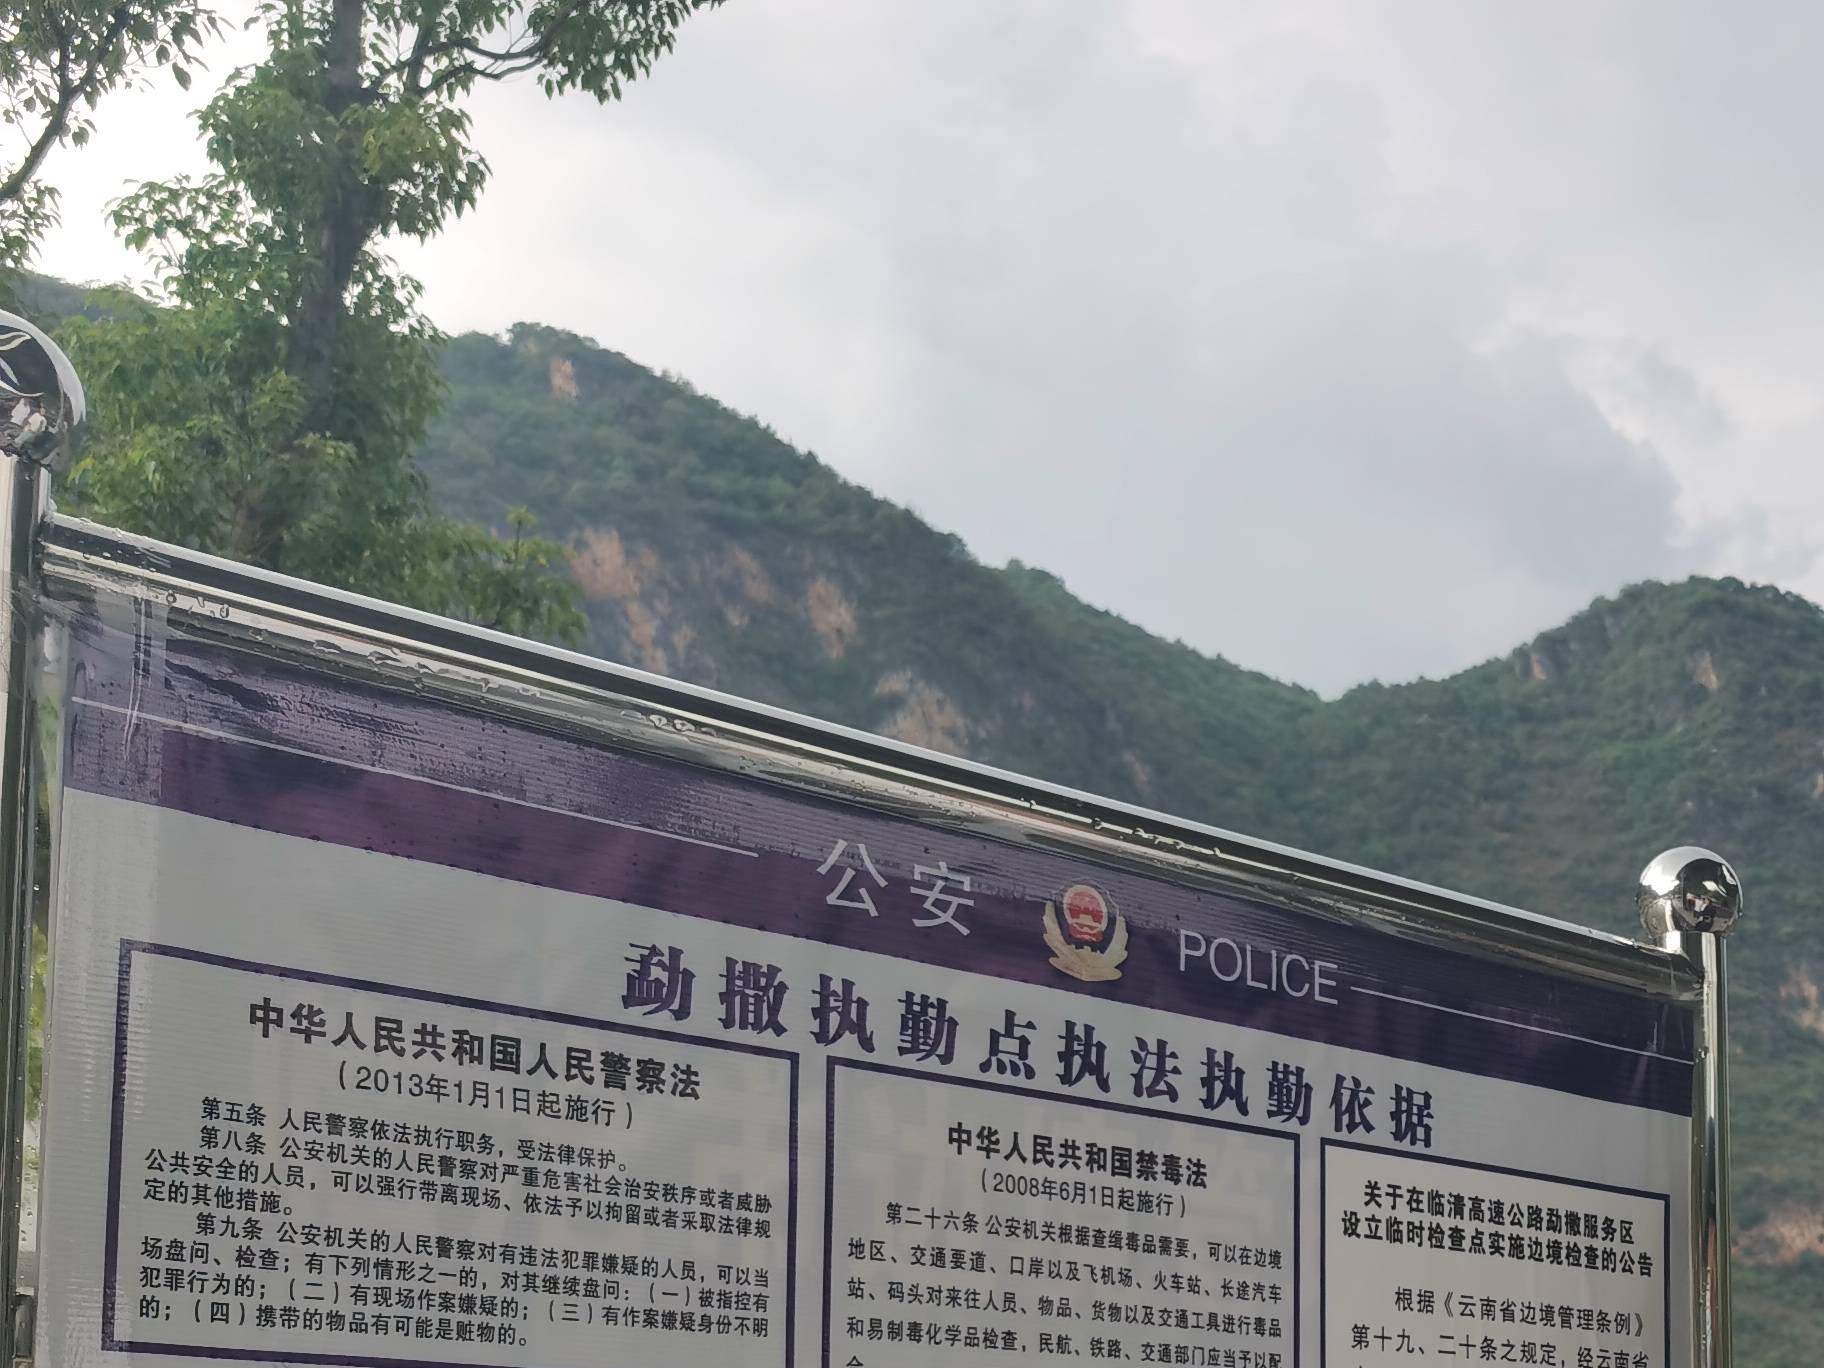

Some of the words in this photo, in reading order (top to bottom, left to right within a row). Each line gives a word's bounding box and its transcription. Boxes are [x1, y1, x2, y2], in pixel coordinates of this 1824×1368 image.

[816, 838, 975, 936] 公安
[1179, 931, 1338, 1005] POLICE
[249, 997, 701, 1100] 中华人民共和国人民警察法
[621, 942, 1435, 1149] 勐撒执勤点执法执勤依据
[338, 1061, 632, 1129] （2013年1月1日起施行）
[948, 1122, 1208, 1189] 中华人民共和国禁毒法
[143, 1181, 294, 1215] 定的其他措施。
[1364, 1180, 1634, 1245] 关于在临清高速公路勐撒服务区
[1342, 1211, 1653, 1278] 设立临时检查点实施边境检查的公告
[1395, 1286, 1644, 1337] 根据《云南省边境管理条例》
